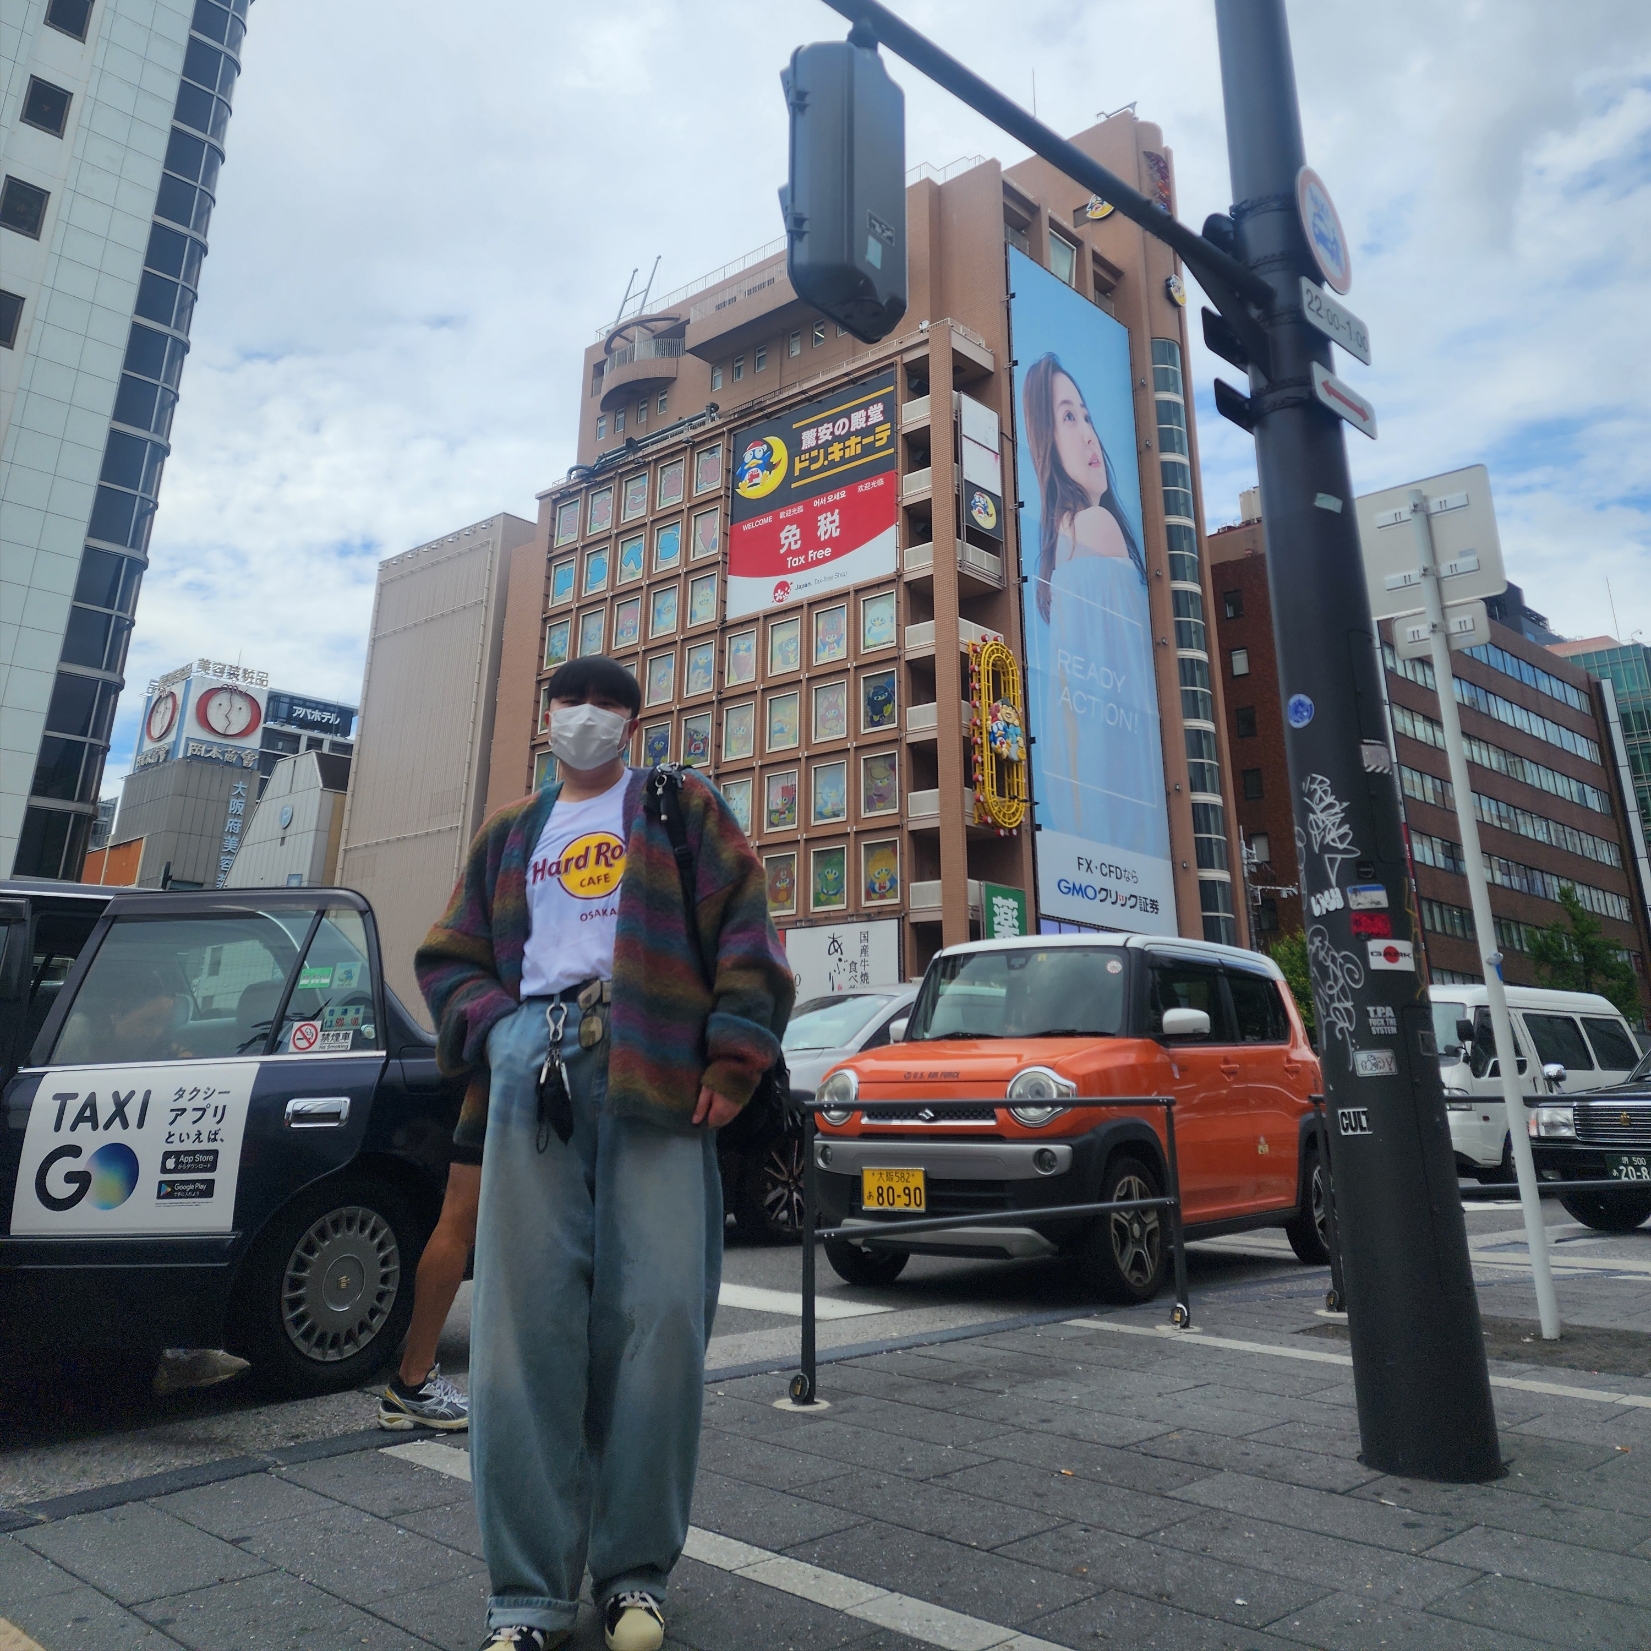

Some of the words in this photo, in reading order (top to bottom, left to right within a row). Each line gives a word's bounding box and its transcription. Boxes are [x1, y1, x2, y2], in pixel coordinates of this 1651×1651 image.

[801, 402, 885, 451] 驚安の殿堂
[742, 515, 773, 532] WELCOME
[786, 553, 806, 569] Tax
[808, 546, 832, 563] Free
[1057, 648, 1126, 694] READY
[291, 705, 341, 725] アパホテル
[1058, 686, 1139, 735] ACTION!
[532, 845, 591, 886] Hard
[594, 841, 625, 868] Ro
[580, 873, 611, 888] CAFE
[1057, 878, 1160, 915] GMOクリック証券
[580, 907, 618, 922] OSAKA
[859, 930, 870, 987] 国産牛焼
[1371, 1026, 1398, 1035] SYSTEM
[172, 1086, 231, 1102] タクシー
[52, 1089, 152, 1133] TAXI
[168, 1103, 227, 1126] アプリ
[164, 1129, 225, 1144] といえば、
[179, 1154, 194, 1164] App
[195, 1153, 214, 1163] Store
[1619, 1165, 1651, 1180] 20-8
[174, 1183, 194, 1192] Google
[195, 1182, 207, 1191] Play
[876, 1185, 923, 1208] 80-90
